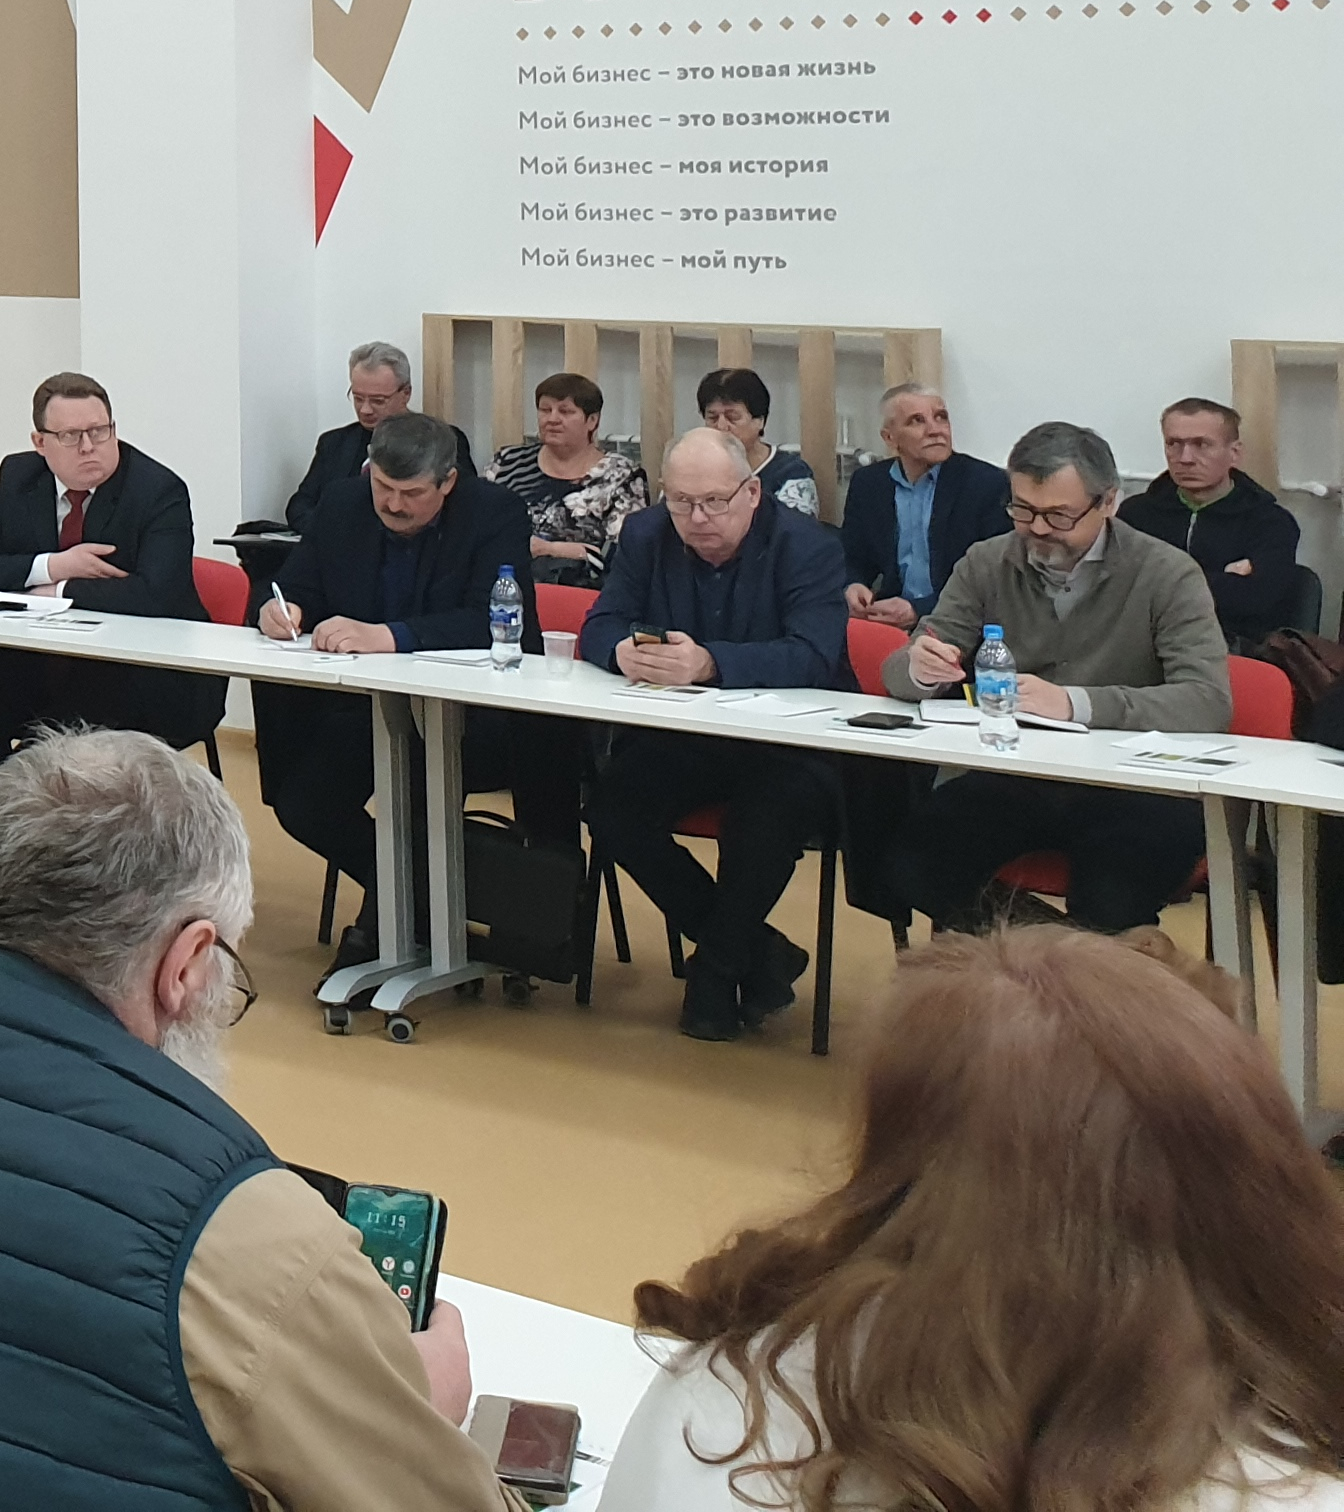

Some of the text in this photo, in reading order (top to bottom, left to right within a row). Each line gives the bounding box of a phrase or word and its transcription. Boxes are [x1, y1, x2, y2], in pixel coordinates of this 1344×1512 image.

[518, 65, 566, 85] Мой
[572, 64, 651, 83] бизнес
[676, 65, 715, 81] это
[721, 62, 791, 80] новая
[797, 60, 877, 78] жизнь
[519, 110, 568, 130] Мой
[573, 110, 652, 129] бизнес
[678, 112, 716, 127] это
[722, 109, 890, 127] возможности
[519, 156, 568, 175] Мой
[573, 155, 653, 175] бизнес
[679, 159, 722, 175] моя
[729, 159, 829, 178] история
[520, 202, 569, 221] Мой
[574, 202, 654, 222] бизнес
[679, 207, 718, 222] это
[724, 206, 837, 226] развитие
[521, 247, 570, 267] Мой
[575, 247, 655, 268] бизнес
[681, 249, 727, 269] мой
[733, 252, 787, 274] путь
